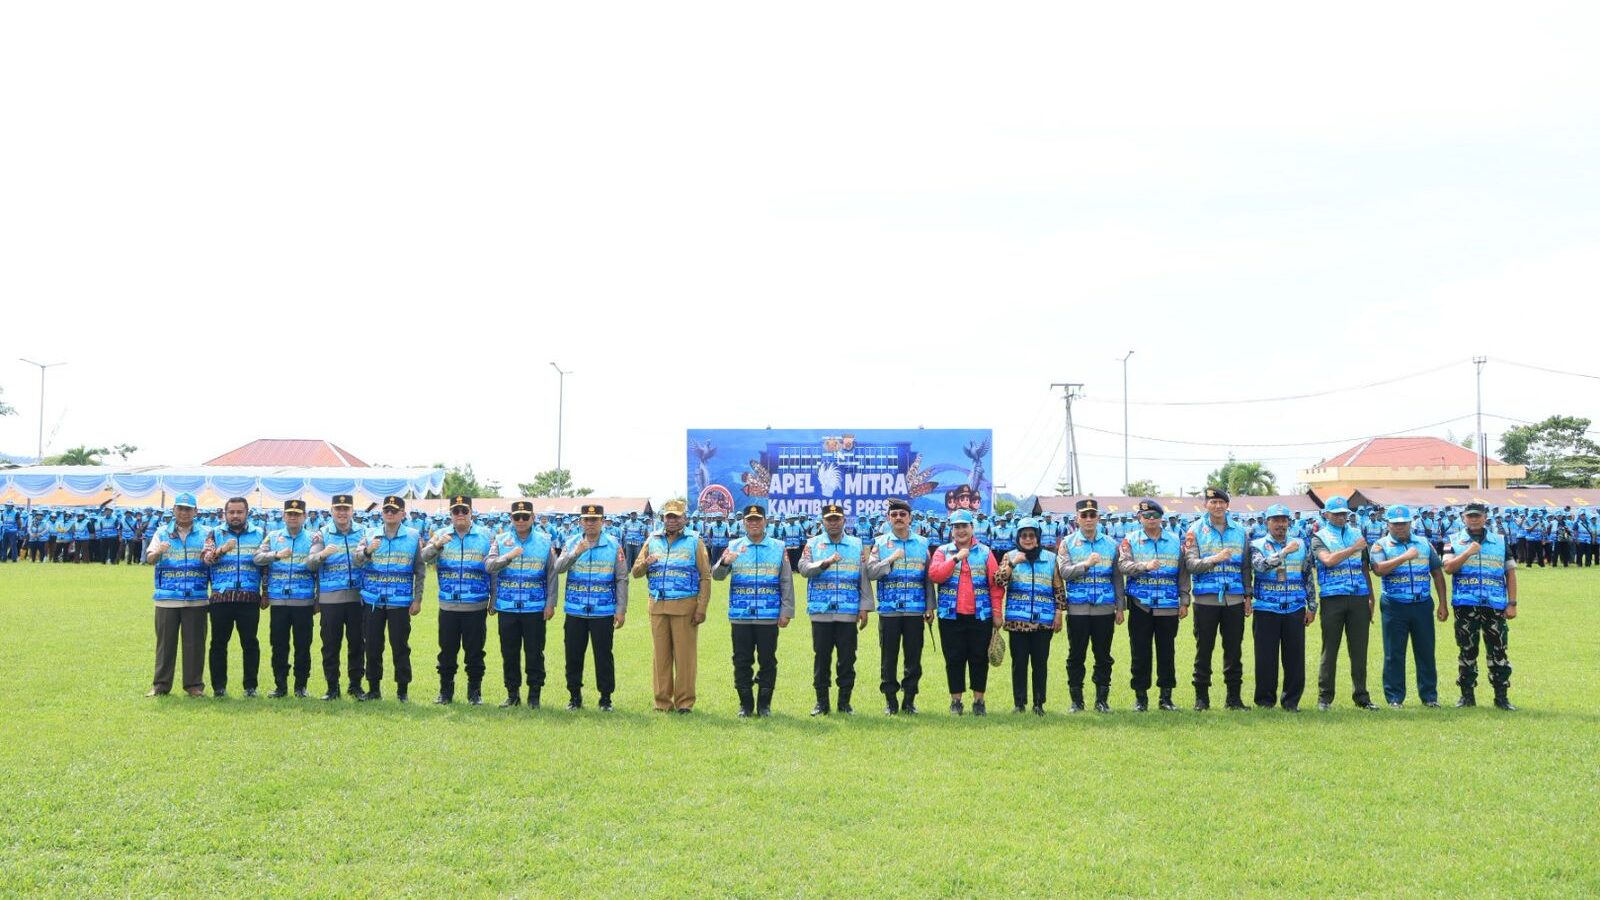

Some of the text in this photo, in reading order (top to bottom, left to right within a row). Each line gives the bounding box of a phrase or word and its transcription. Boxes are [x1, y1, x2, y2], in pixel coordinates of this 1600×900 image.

[769, 473, 908, 496] APEL MITRA
[855, 499, 890, 515] PRES
